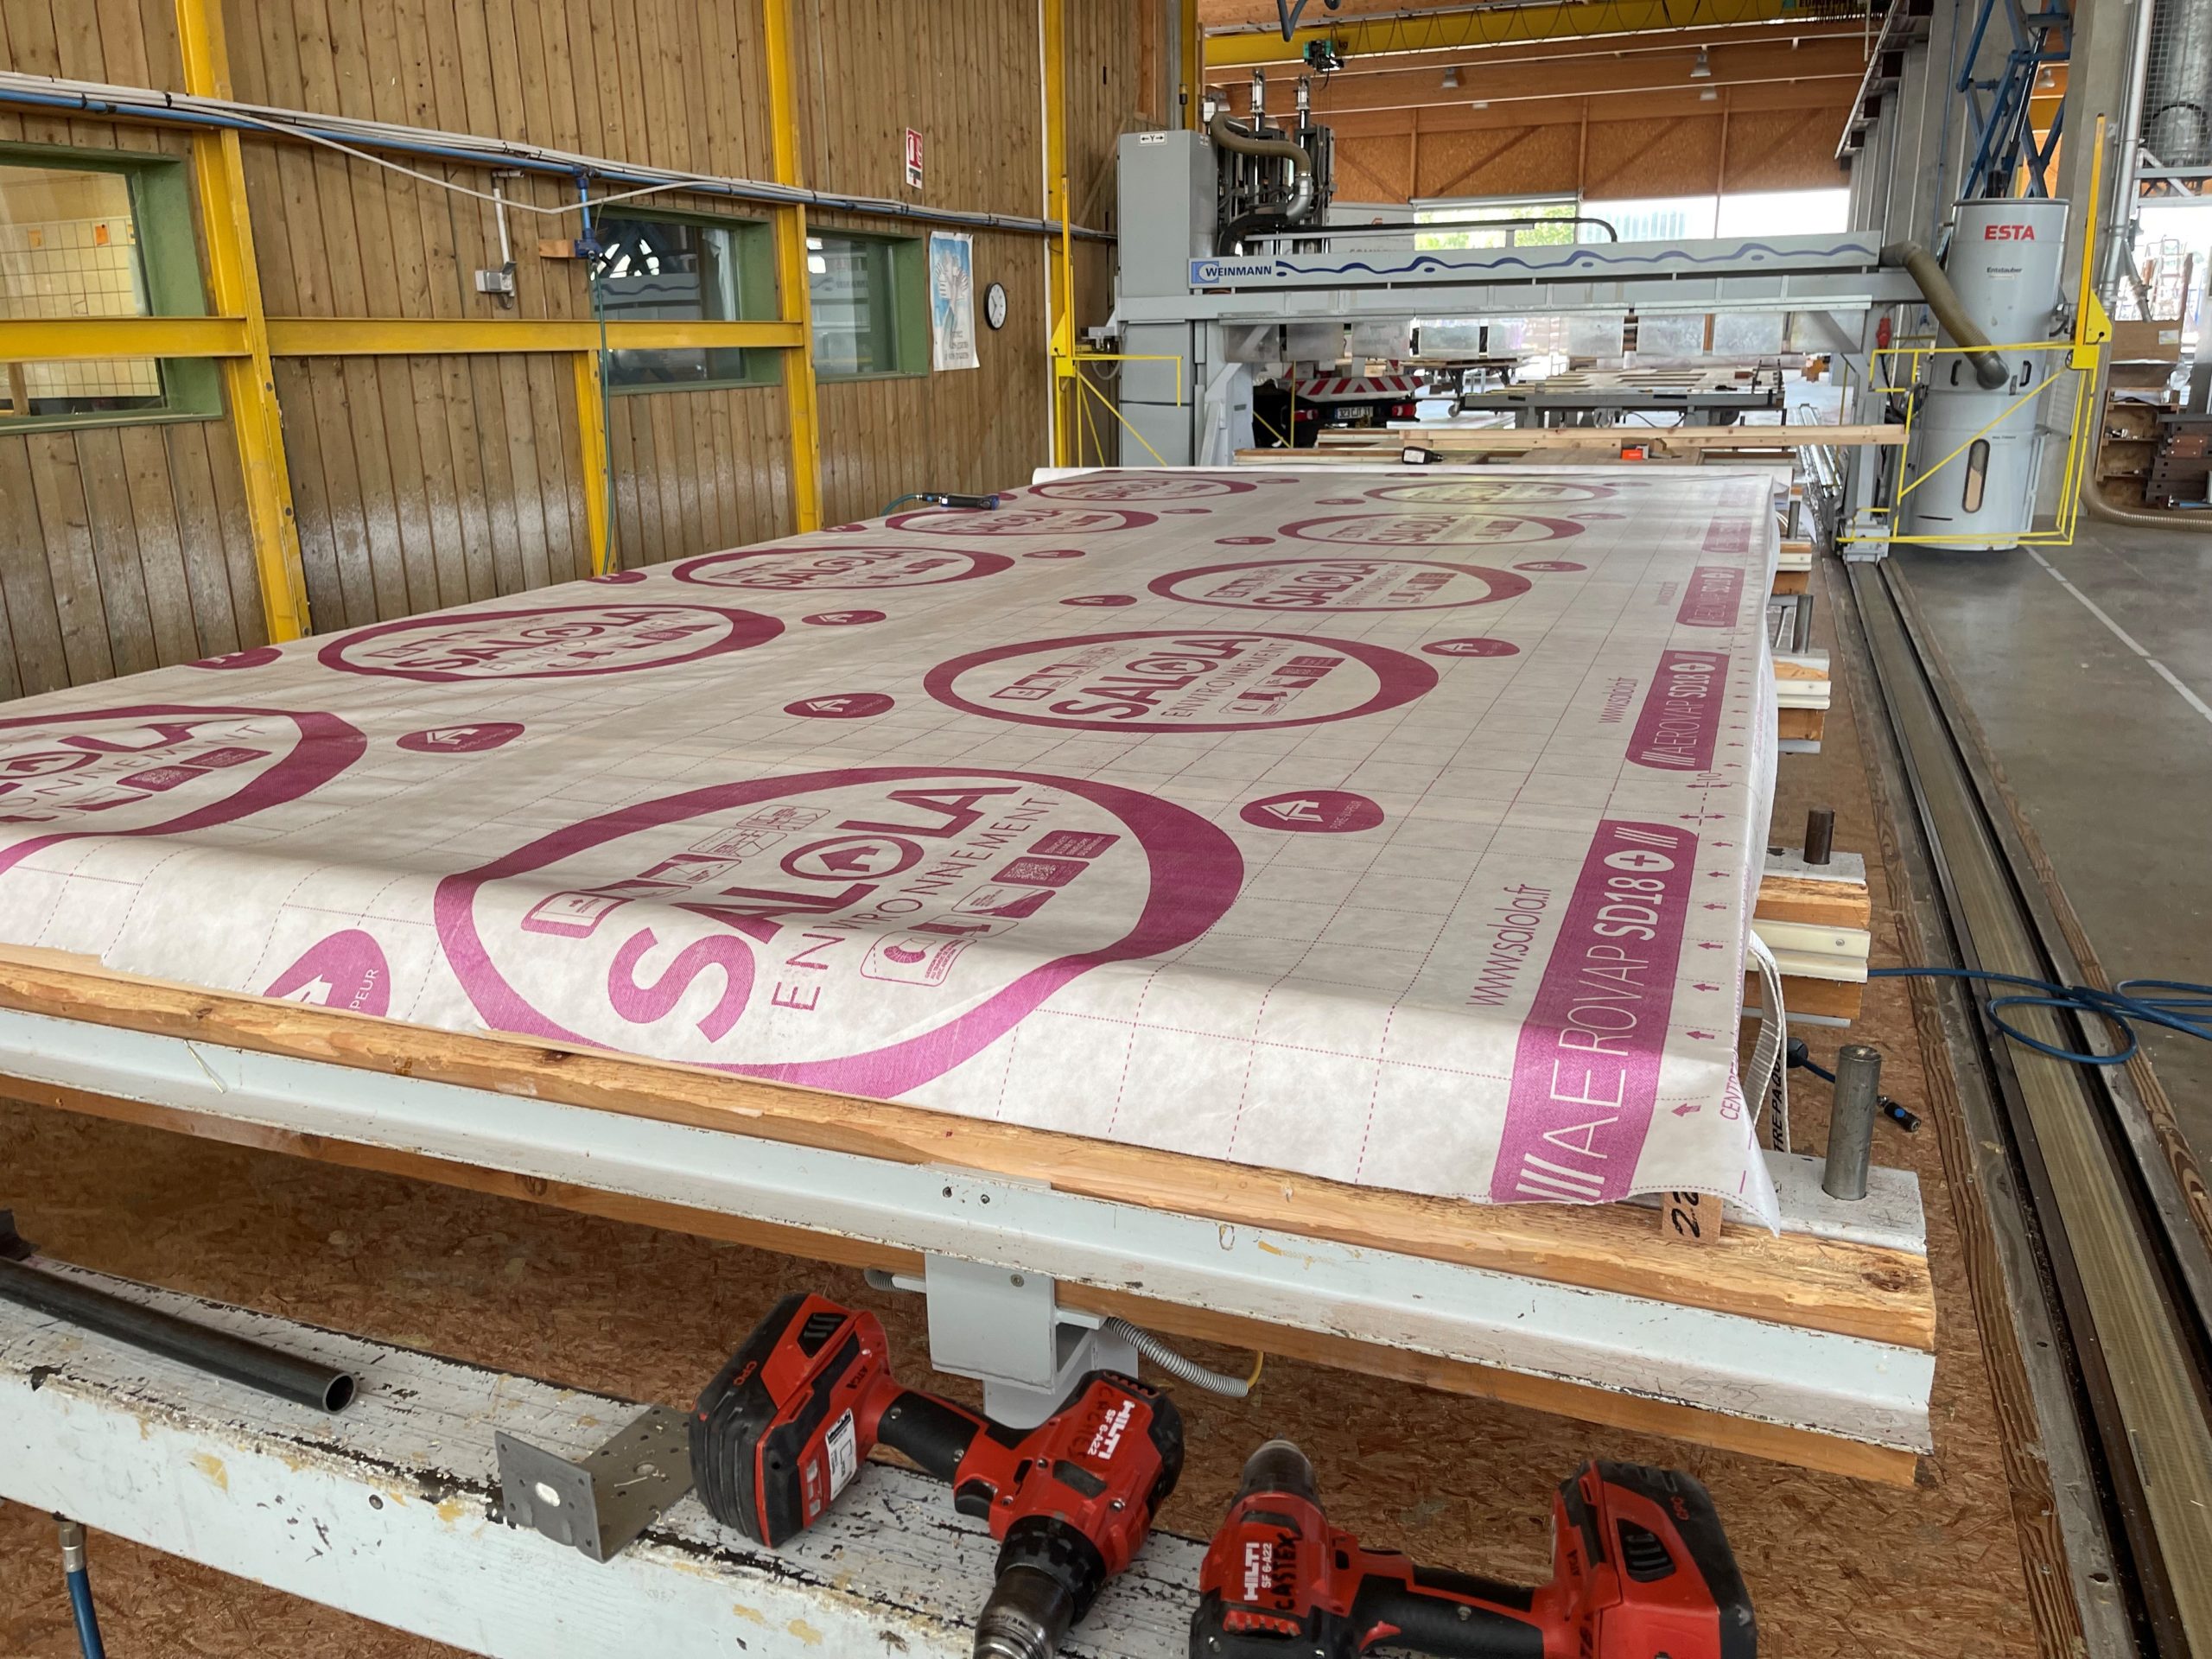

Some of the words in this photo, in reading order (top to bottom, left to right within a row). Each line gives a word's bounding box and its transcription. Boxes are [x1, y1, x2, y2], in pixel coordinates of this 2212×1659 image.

[1984, 226, 2035, 240] ESTA
[1205, 265, 1272, 277] WEINMANN
[1252, 561, 1389, 607] SALOLA
[394, 611, 684, 670] SALOLA
[1049, 638, 1263, 719] SALOLA
[1160, 642, 1294, 717] ENVIRONNEMENT
[1652, 700, 1705, 756] AEROVAP
[608, 786, 1022, 1043] SALOLA
[772, 798, 1059, 1010] ENVIRONNEMENT
[1465, 883, 1552, 1007] www.salola.fr
[1542, 944, 1649, 1160] AEROVAP
[734, 1360, 757, 1386] CPC
[1087, 1424, 1109, 1456] 6-A22
[1098, 1400, 1135, 1460] HILTI
[1104, 1408, 1116, 1424] SF
[1244, 1542, 1260, 1601] HILTI
[1262, 1542, 1273, 1573] 6-A22
[1262, 1574, 1272, 1588] SF
